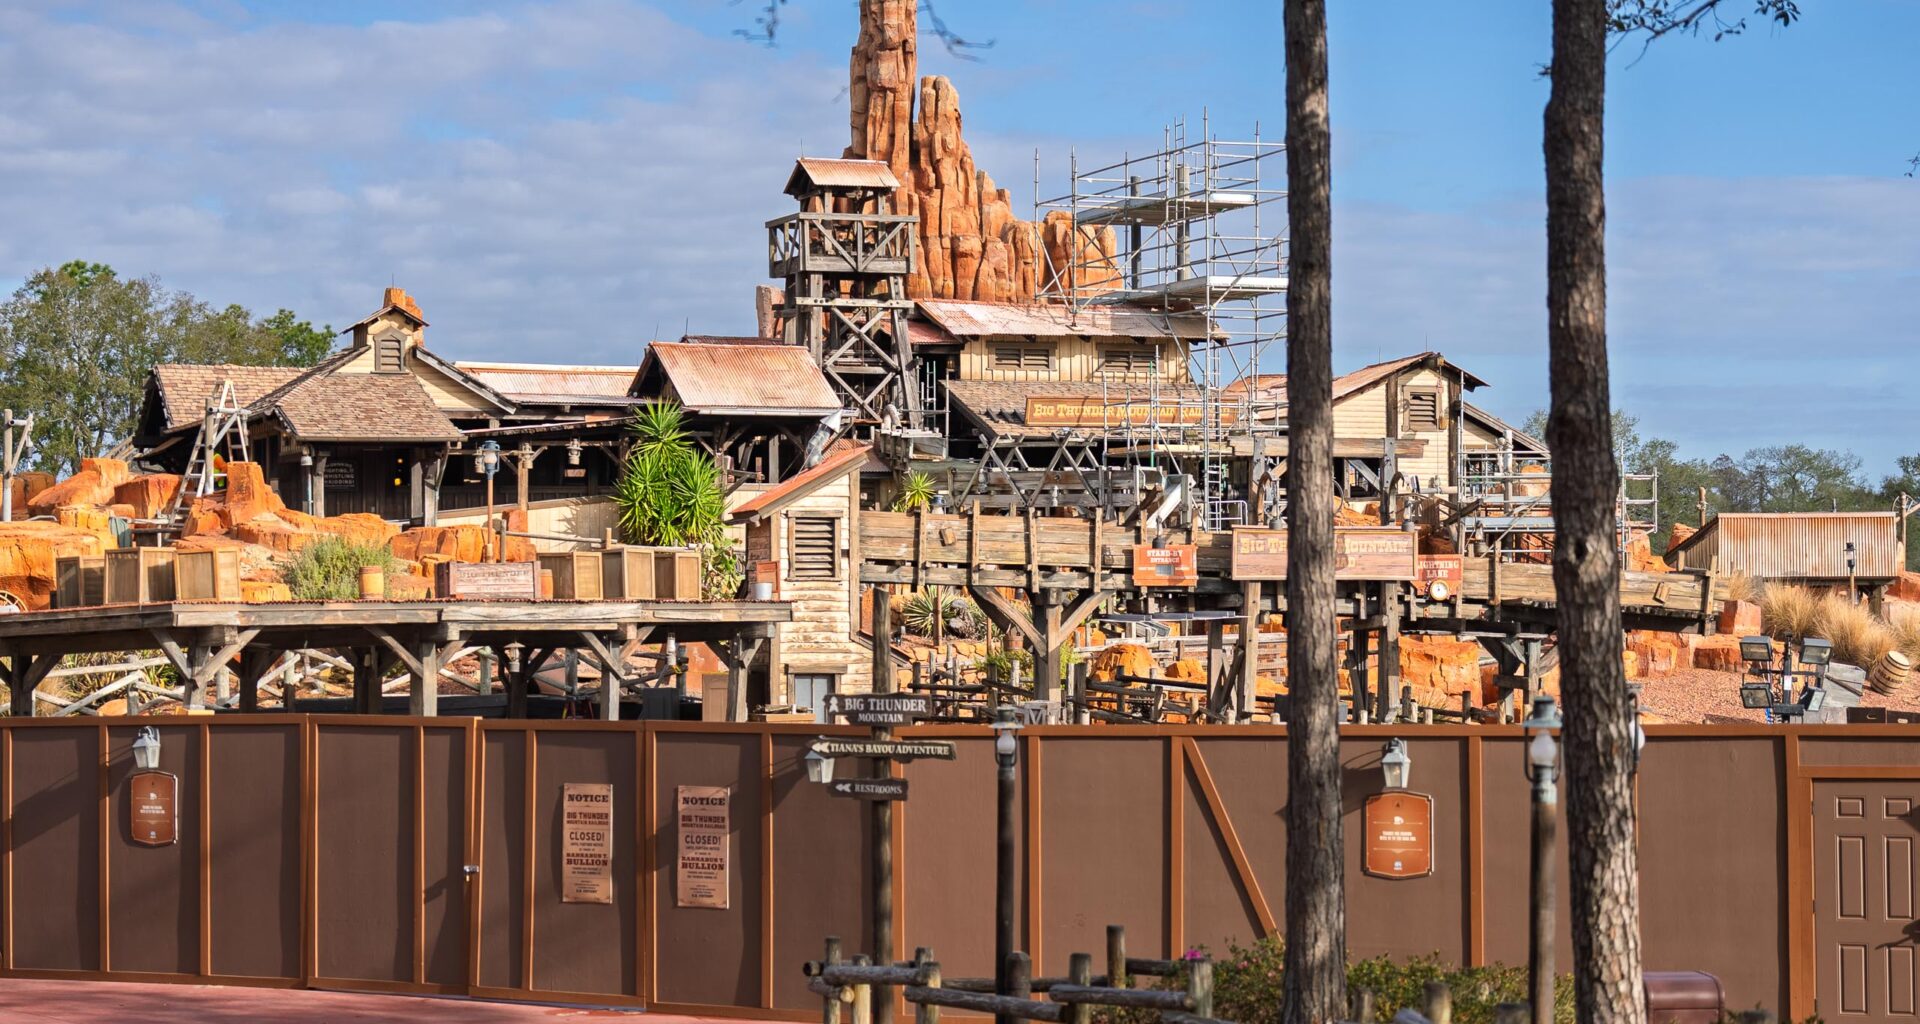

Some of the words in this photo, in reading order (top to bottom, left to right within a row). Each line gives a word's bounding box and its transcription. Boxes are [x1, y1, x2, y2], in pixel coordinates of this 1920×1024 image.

[1032, 404, 1054, 417] BIG
[1056, 404, 1114, 418] THUNDER
[1181, 406, 1231, 418] RAILD
[1240, 538, 1265, 553] BIG
[1146, 549, 1183, 557] STAND-BY
[1426, 569, 1449, 578] LANE
[844, 698, 865, 711] BIG
[867, 698, 927, 713] THUNDER
[858, 713, 904, 723] MOUNTAIN
[830, 743, 864, 753] TIANA'S
[865, 744, 895, 754] BAYOU
[896, 746, 950, 756] ADVENTURE
[854, 783, 903, 794] RESTROOMS
[567, 794, 609, 803] NOTICE
[682, 796, 726, 806] NOTICE
[579, 812, 609, 820] THUNDER
[694, 815, 726, 824] THUNDER
[569, 831, 605, 842] CLOSED!
[685, 834, 721, 845] CLOSED!
[566, 859, 608, 867] BULLION
[681, 862, 725, 871] BULLION
